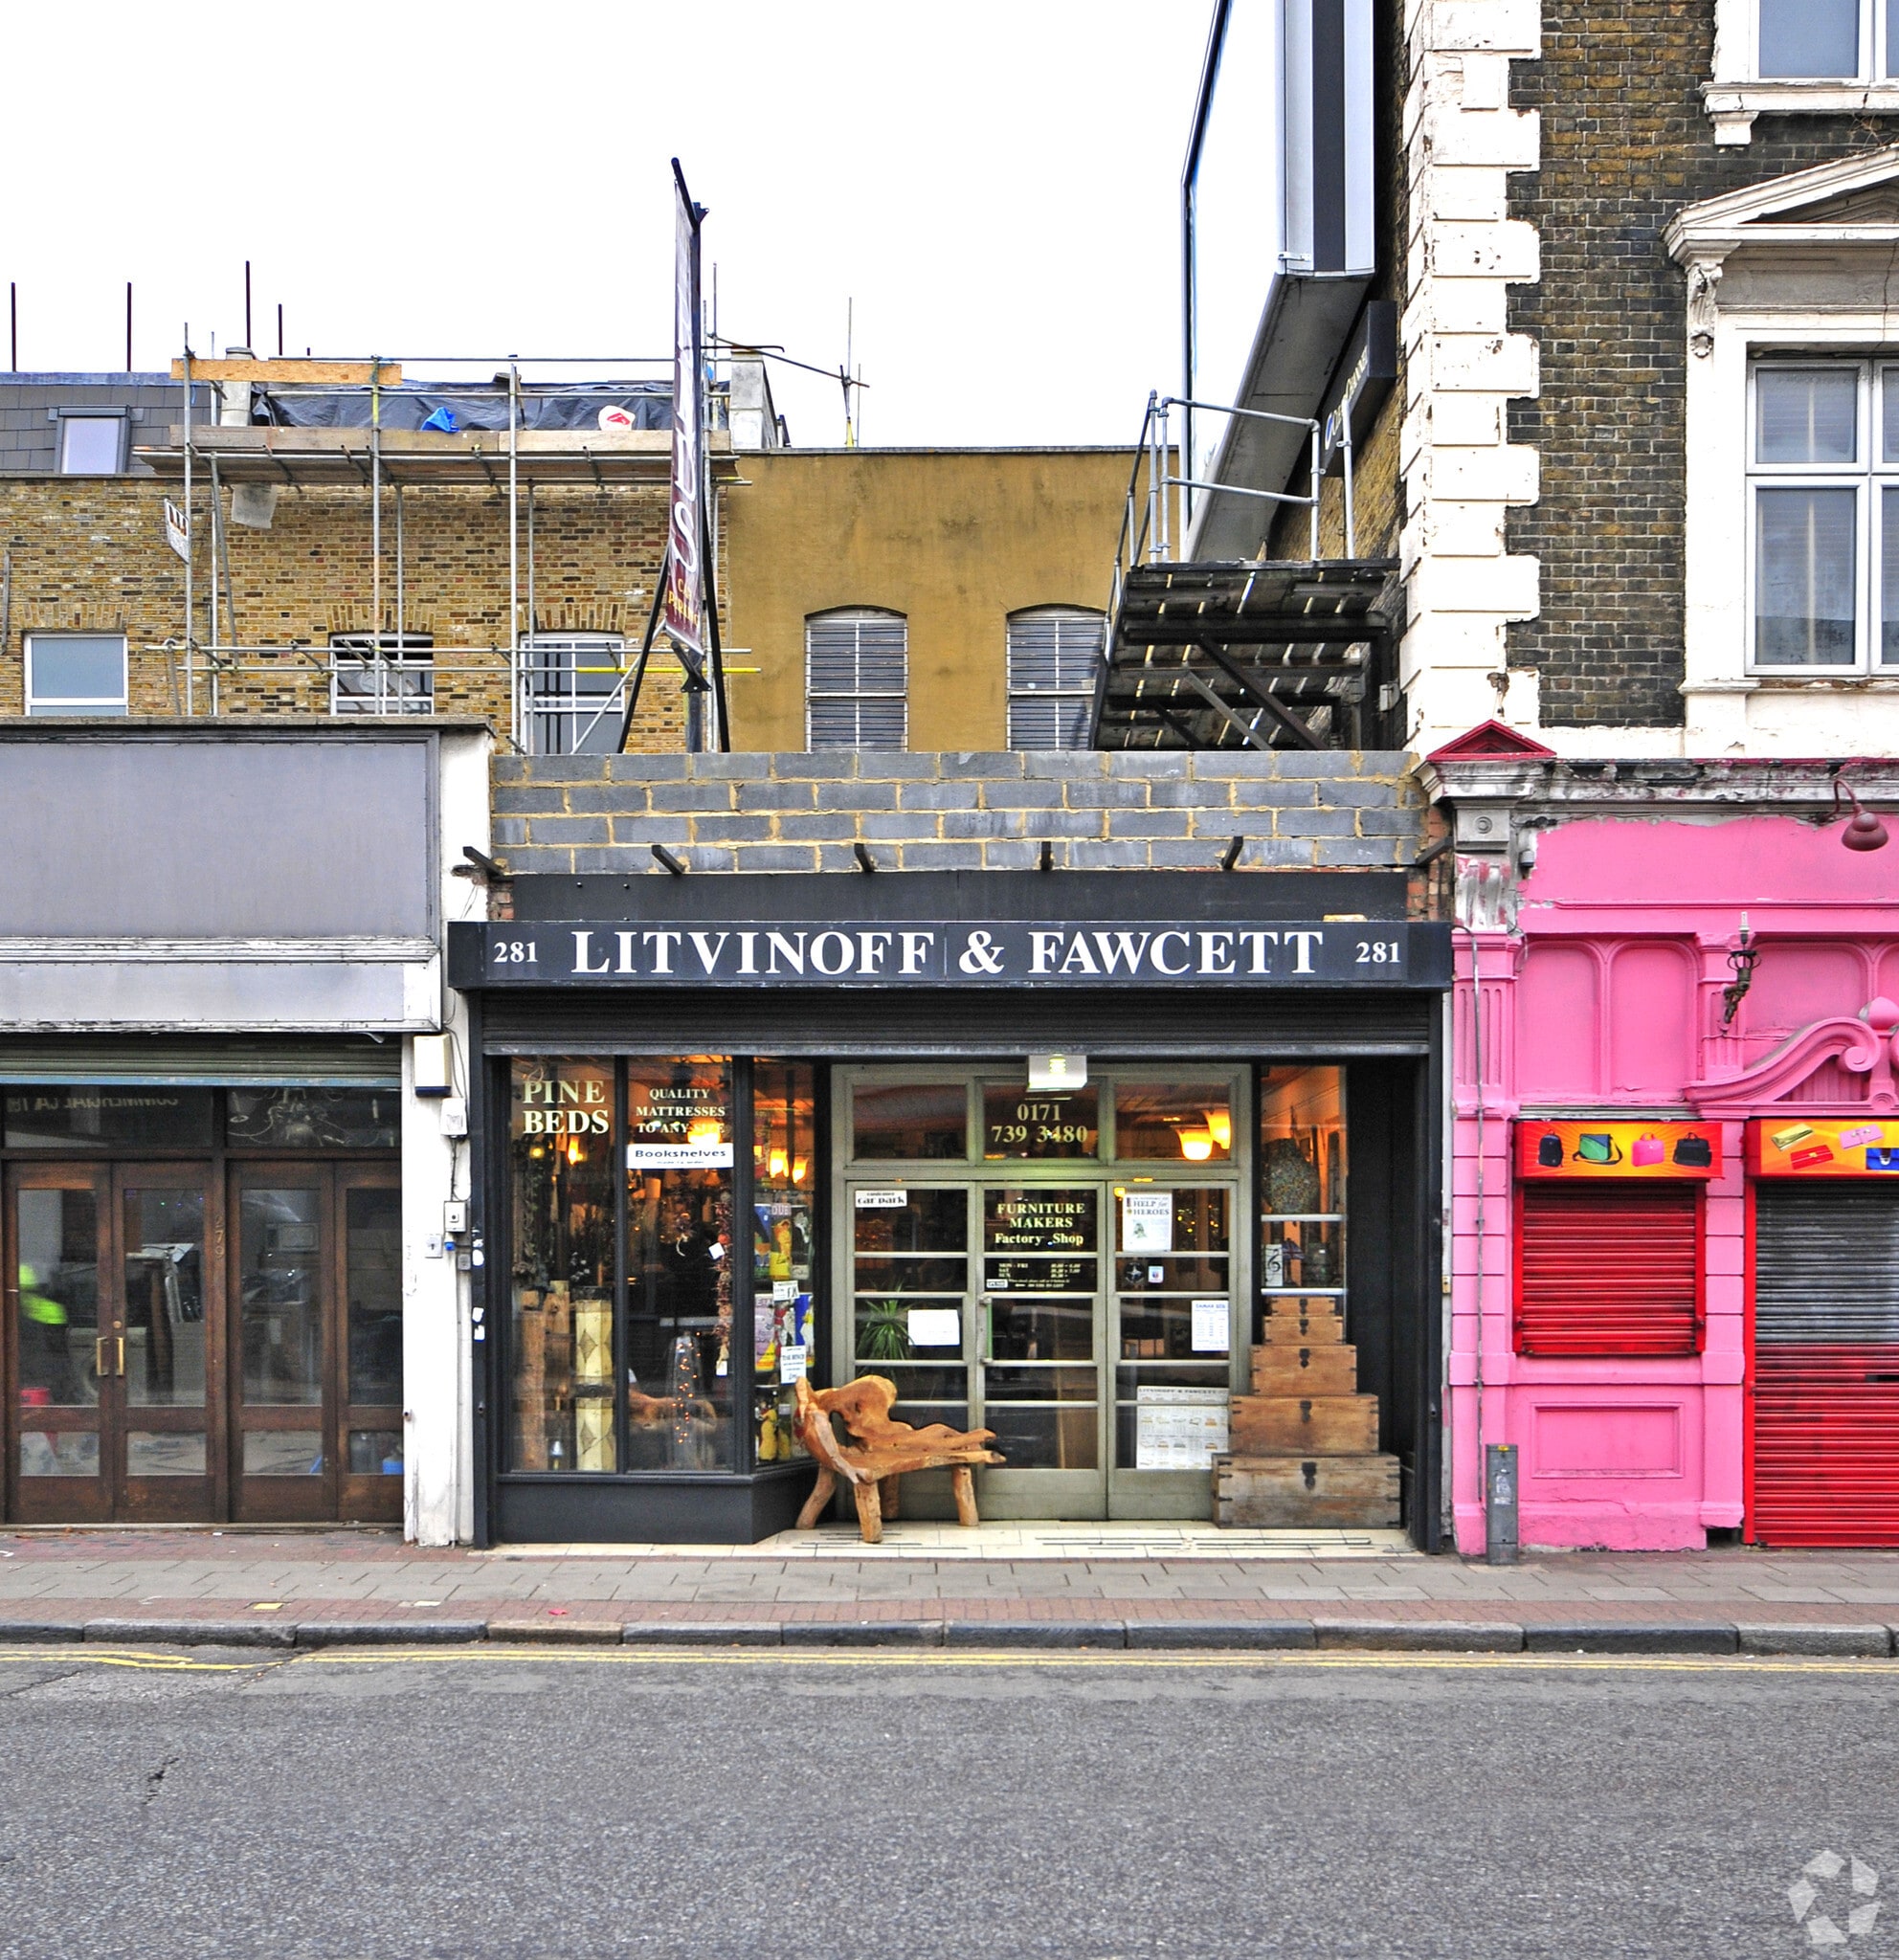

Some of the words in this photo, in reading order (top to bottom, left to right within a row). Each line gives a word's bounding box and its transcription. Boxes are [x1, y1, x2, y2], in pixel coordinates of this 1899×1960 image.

[493, 941, 538, 964] 281
[570, 931, 935, 976] LITVINOFF
[959, 929, 1005, 975] &
[1027, 931, 1325, 975] FAWCETT
[1355, 942, 1401, 964] 281
[523, 1080, 605, 1104] PINE
[649, 1088, 710, 1102] QUALITY
[636, 1106, 726, 1117] MATTRESSES
[1017, 1103, 1061, 1122] 0171
[523, 1110, 610, 1135] BEDS
[637, 1123, 658, 1133] TO
[660, 1123, 689, 1133] ANY
[991, 1125, 1027, 1143] 739
[1037, 1125, 1088, 1143] 3480
[635, 1149, 726, 1158] Bookshelves
[996, 1203, 1085, 1214] FURNITURE
[1010, 1216, 1073, 1228] MAKERS
[994, 1233, 1043, 1246] Factory
[1052, 1233, 1084, 1246] Shop
